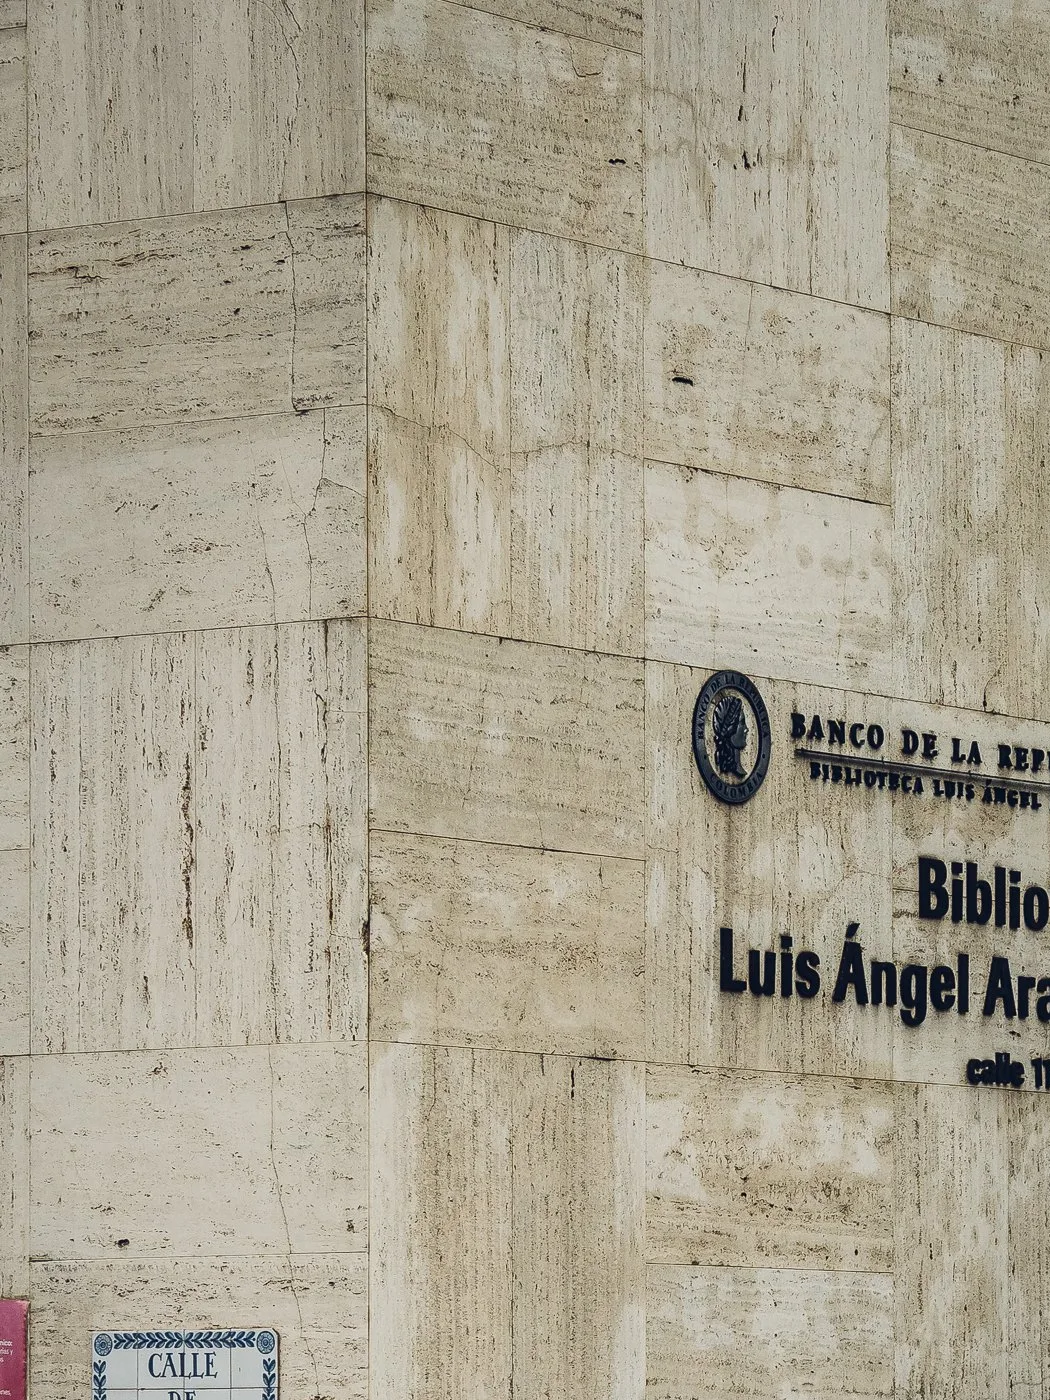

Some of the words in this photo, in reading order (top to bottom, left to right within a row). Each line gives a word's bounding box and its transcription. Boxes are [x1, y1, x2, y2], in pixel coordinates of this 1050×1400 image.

[791, 712, 884, 749] BANCO
[901, 729, 937, 758] DE
[951, 737, 982, 765] LA
[810, 761, 924, 794] BIBLIOTECA
[932, 778, 975, 801] LUIS
[982, 779, 1042, 810] ÁNGEL
[719, 927, 820, 999] Luis
[832, 923, 970, 1027] Ángel
[966, 1051, 1025, 1088] calle
[148, 1351, 218, 1380] CALLE
